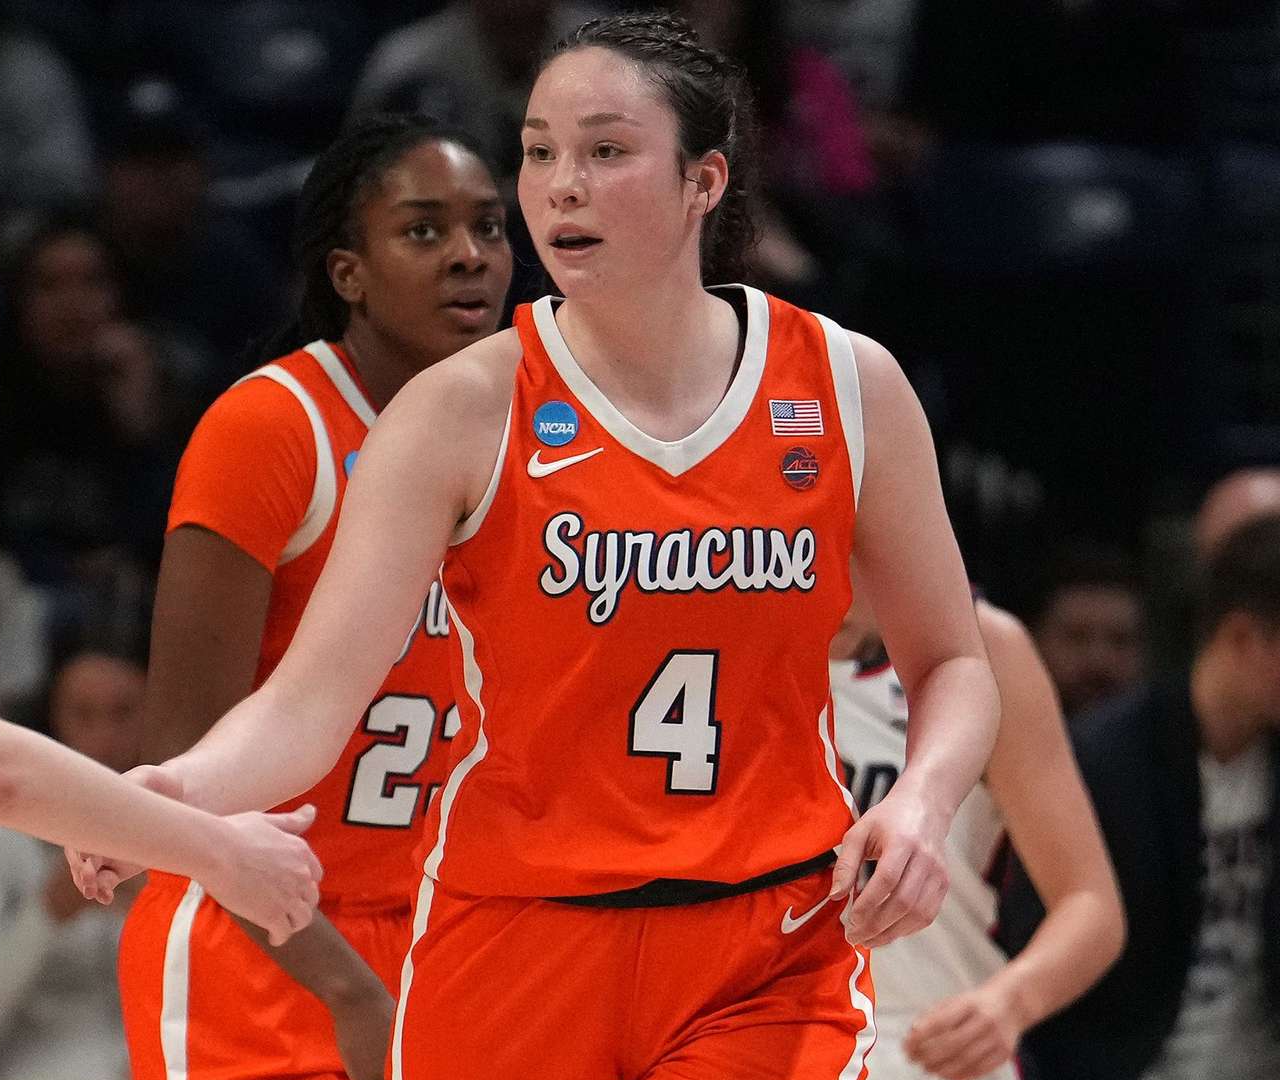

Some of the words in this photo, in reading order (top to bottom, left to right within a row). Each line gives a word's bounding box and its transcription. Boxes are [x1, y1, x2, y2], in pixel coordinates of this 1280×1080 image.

[539, 421, 576, 434] NCAA
[539, 510, 818, 625] Syracuse
[626, 648, 720, 796] 4
